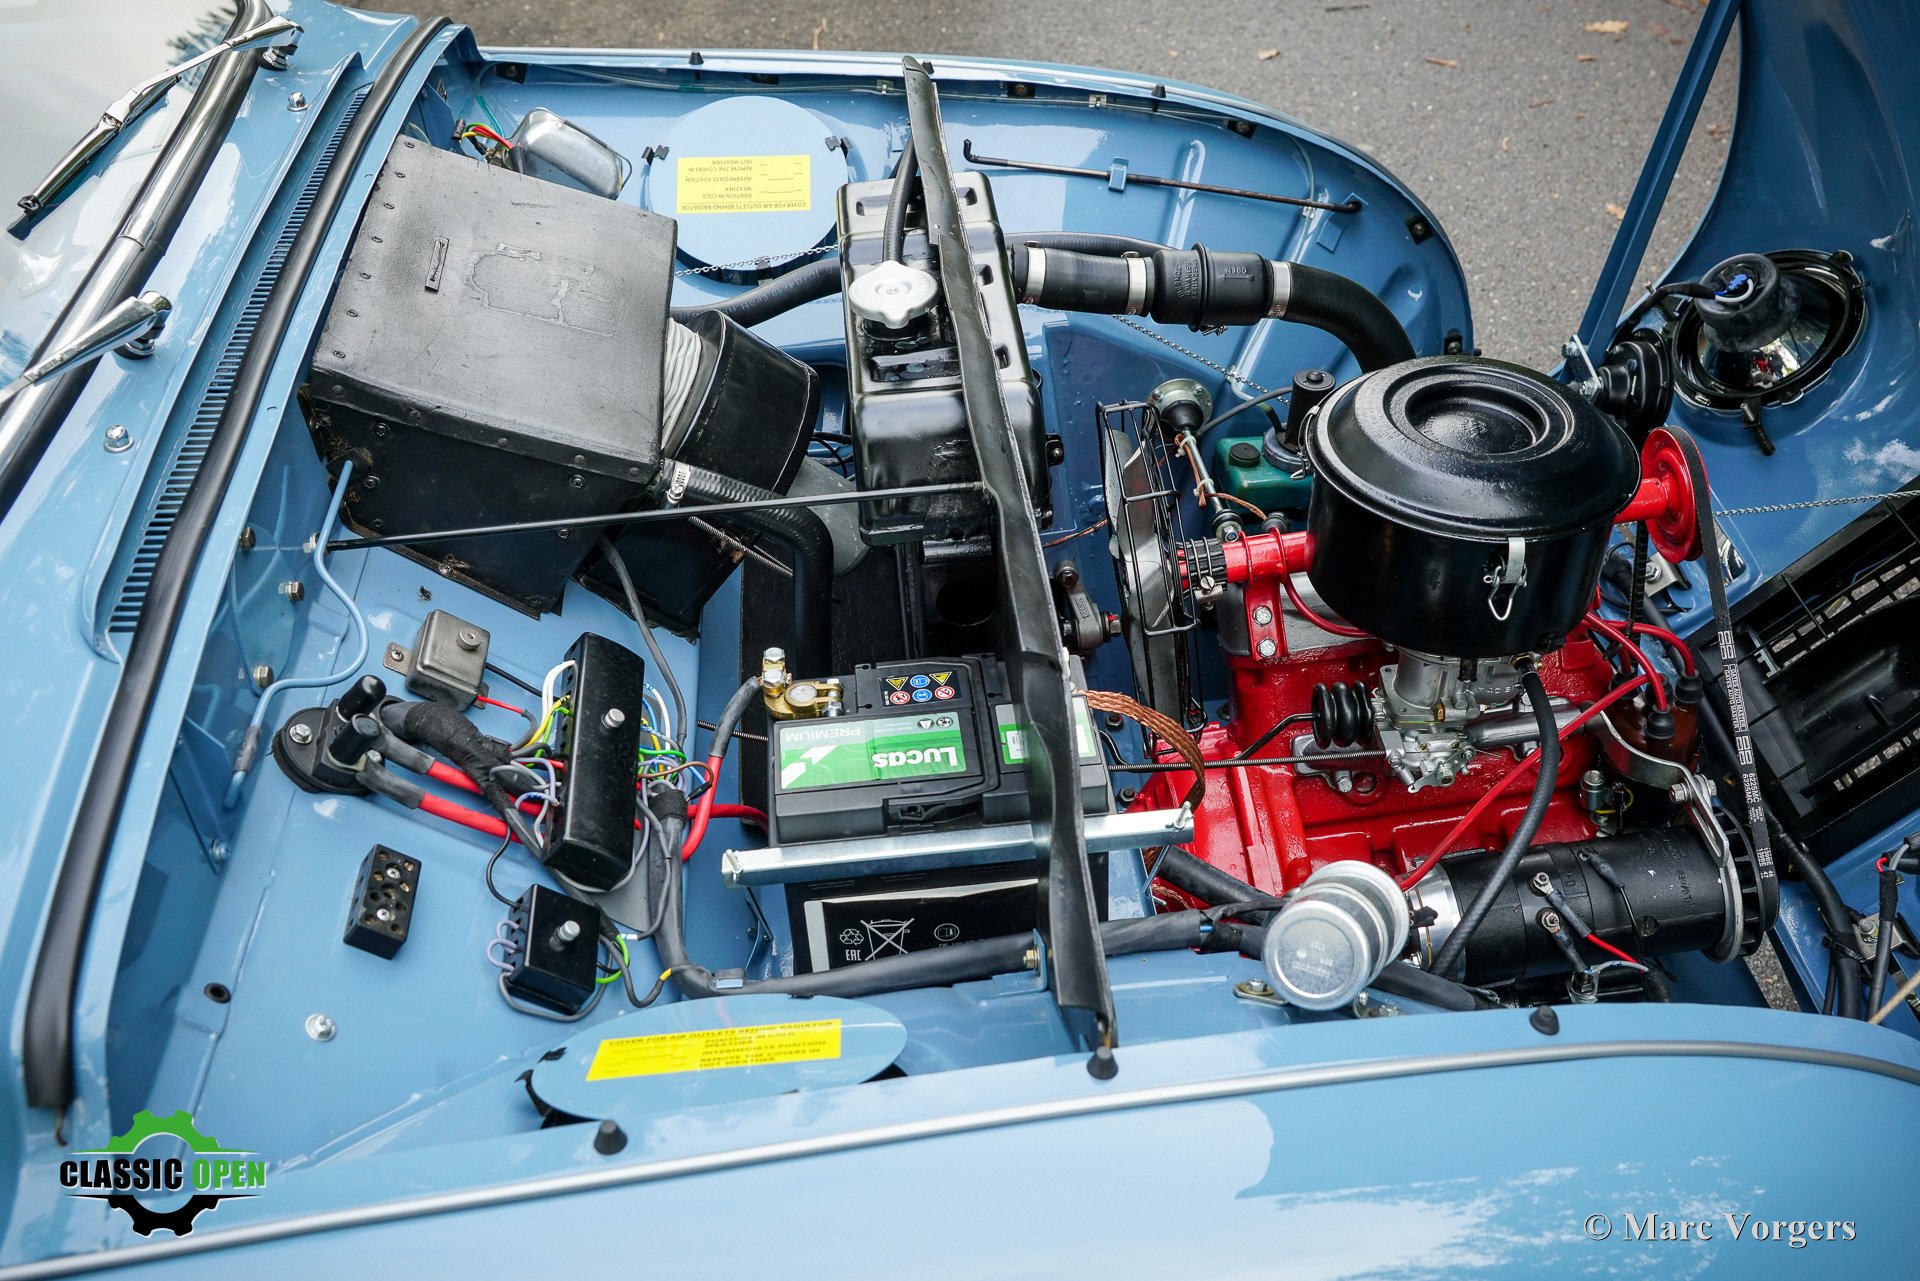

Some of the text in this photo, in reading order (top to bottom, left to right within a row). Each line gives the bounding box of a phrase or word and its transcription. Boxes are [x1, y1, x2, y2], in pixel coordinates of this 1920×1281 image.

[785, 726, 861, 743] PREMIUM
[872, 746, 956, 768] Lucas
[1742, 773, 1753, 804] 6225MC
[1748, 772, 1760, 803] 6225MC
[845, 949, 862, 961] EAC
[608, 1038, 645, 1046] COVER
[689, 1029, 736, 1039] OUTLETS
